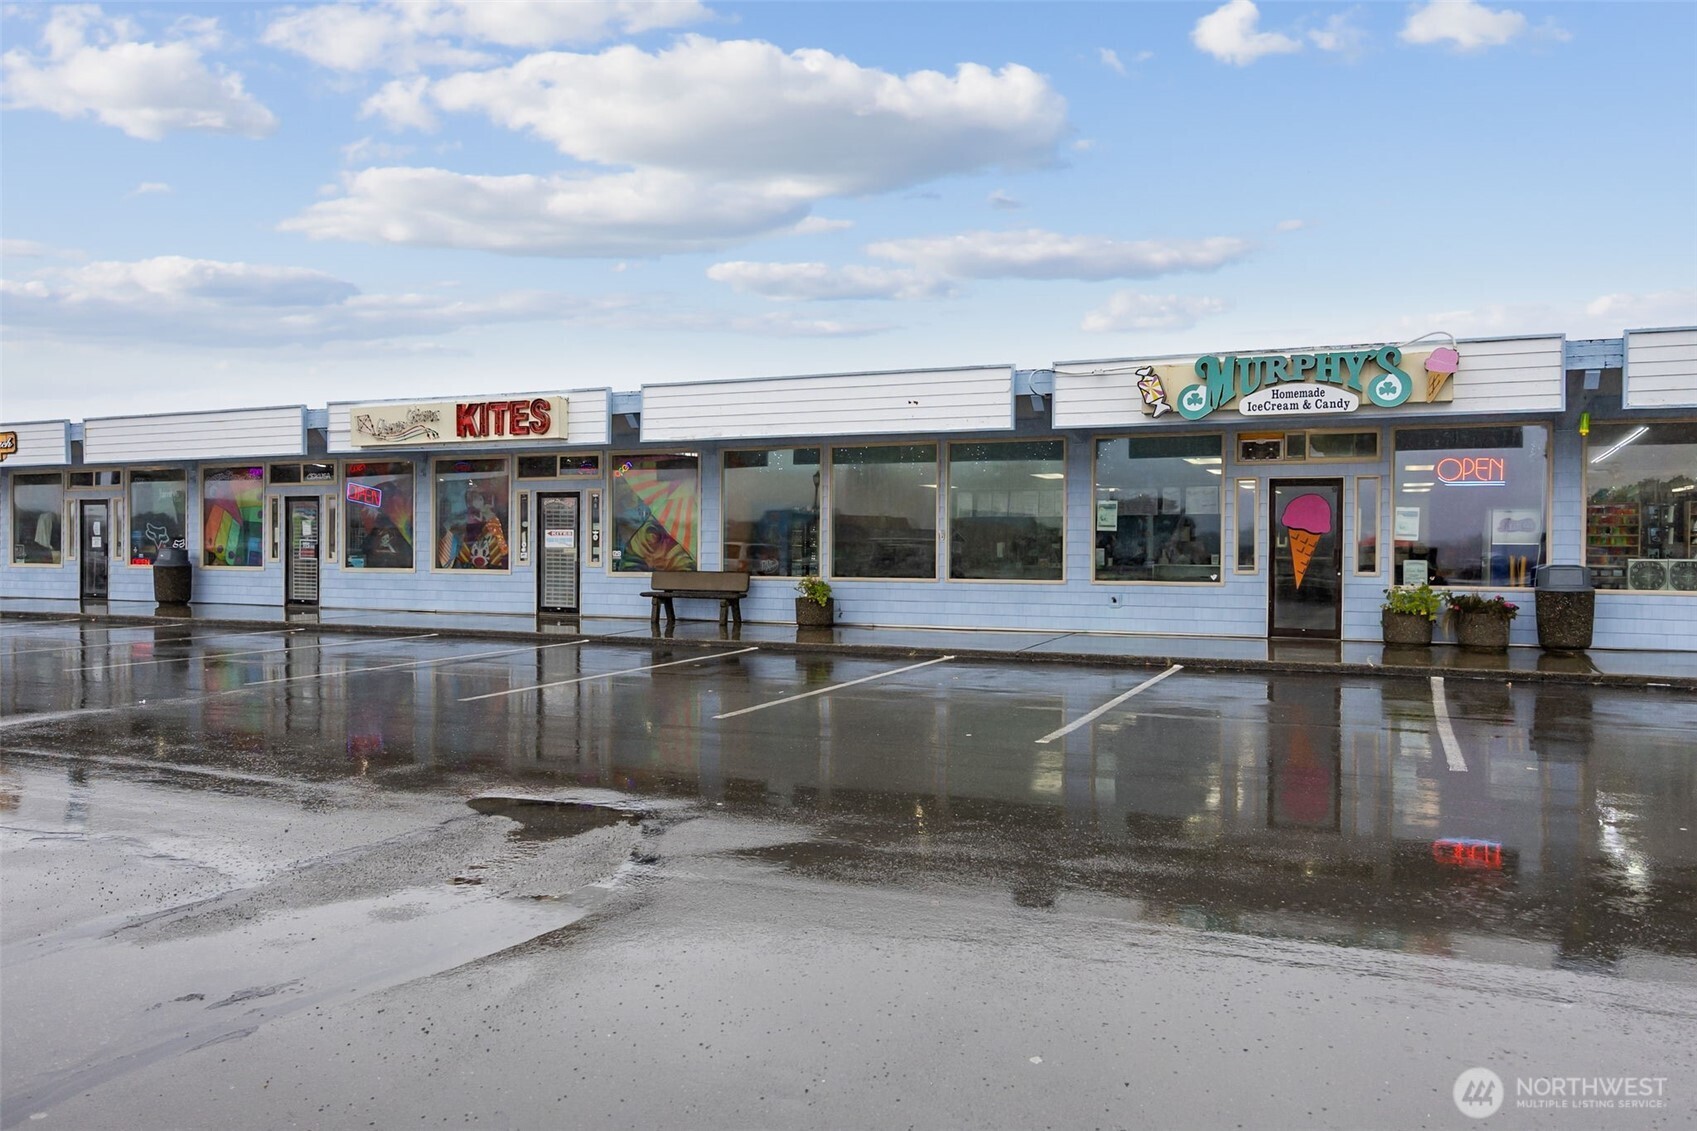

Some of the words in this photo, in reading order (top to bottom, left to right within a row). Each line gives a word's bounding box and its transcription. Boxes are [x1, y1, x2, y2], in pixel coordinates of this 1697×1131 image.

[1177, 346, 1413, 421] MURPHY'S
[1271, 388, 1325, 399] Homemade
[1247, 401, 1299, 411] IceCream
[1302, 400, 1312, 410] &
[1315, 398, 1350, 410] Candy
[456, 398, 551, 437] KITES
[1437, 457, 1504, 482] OPEN
